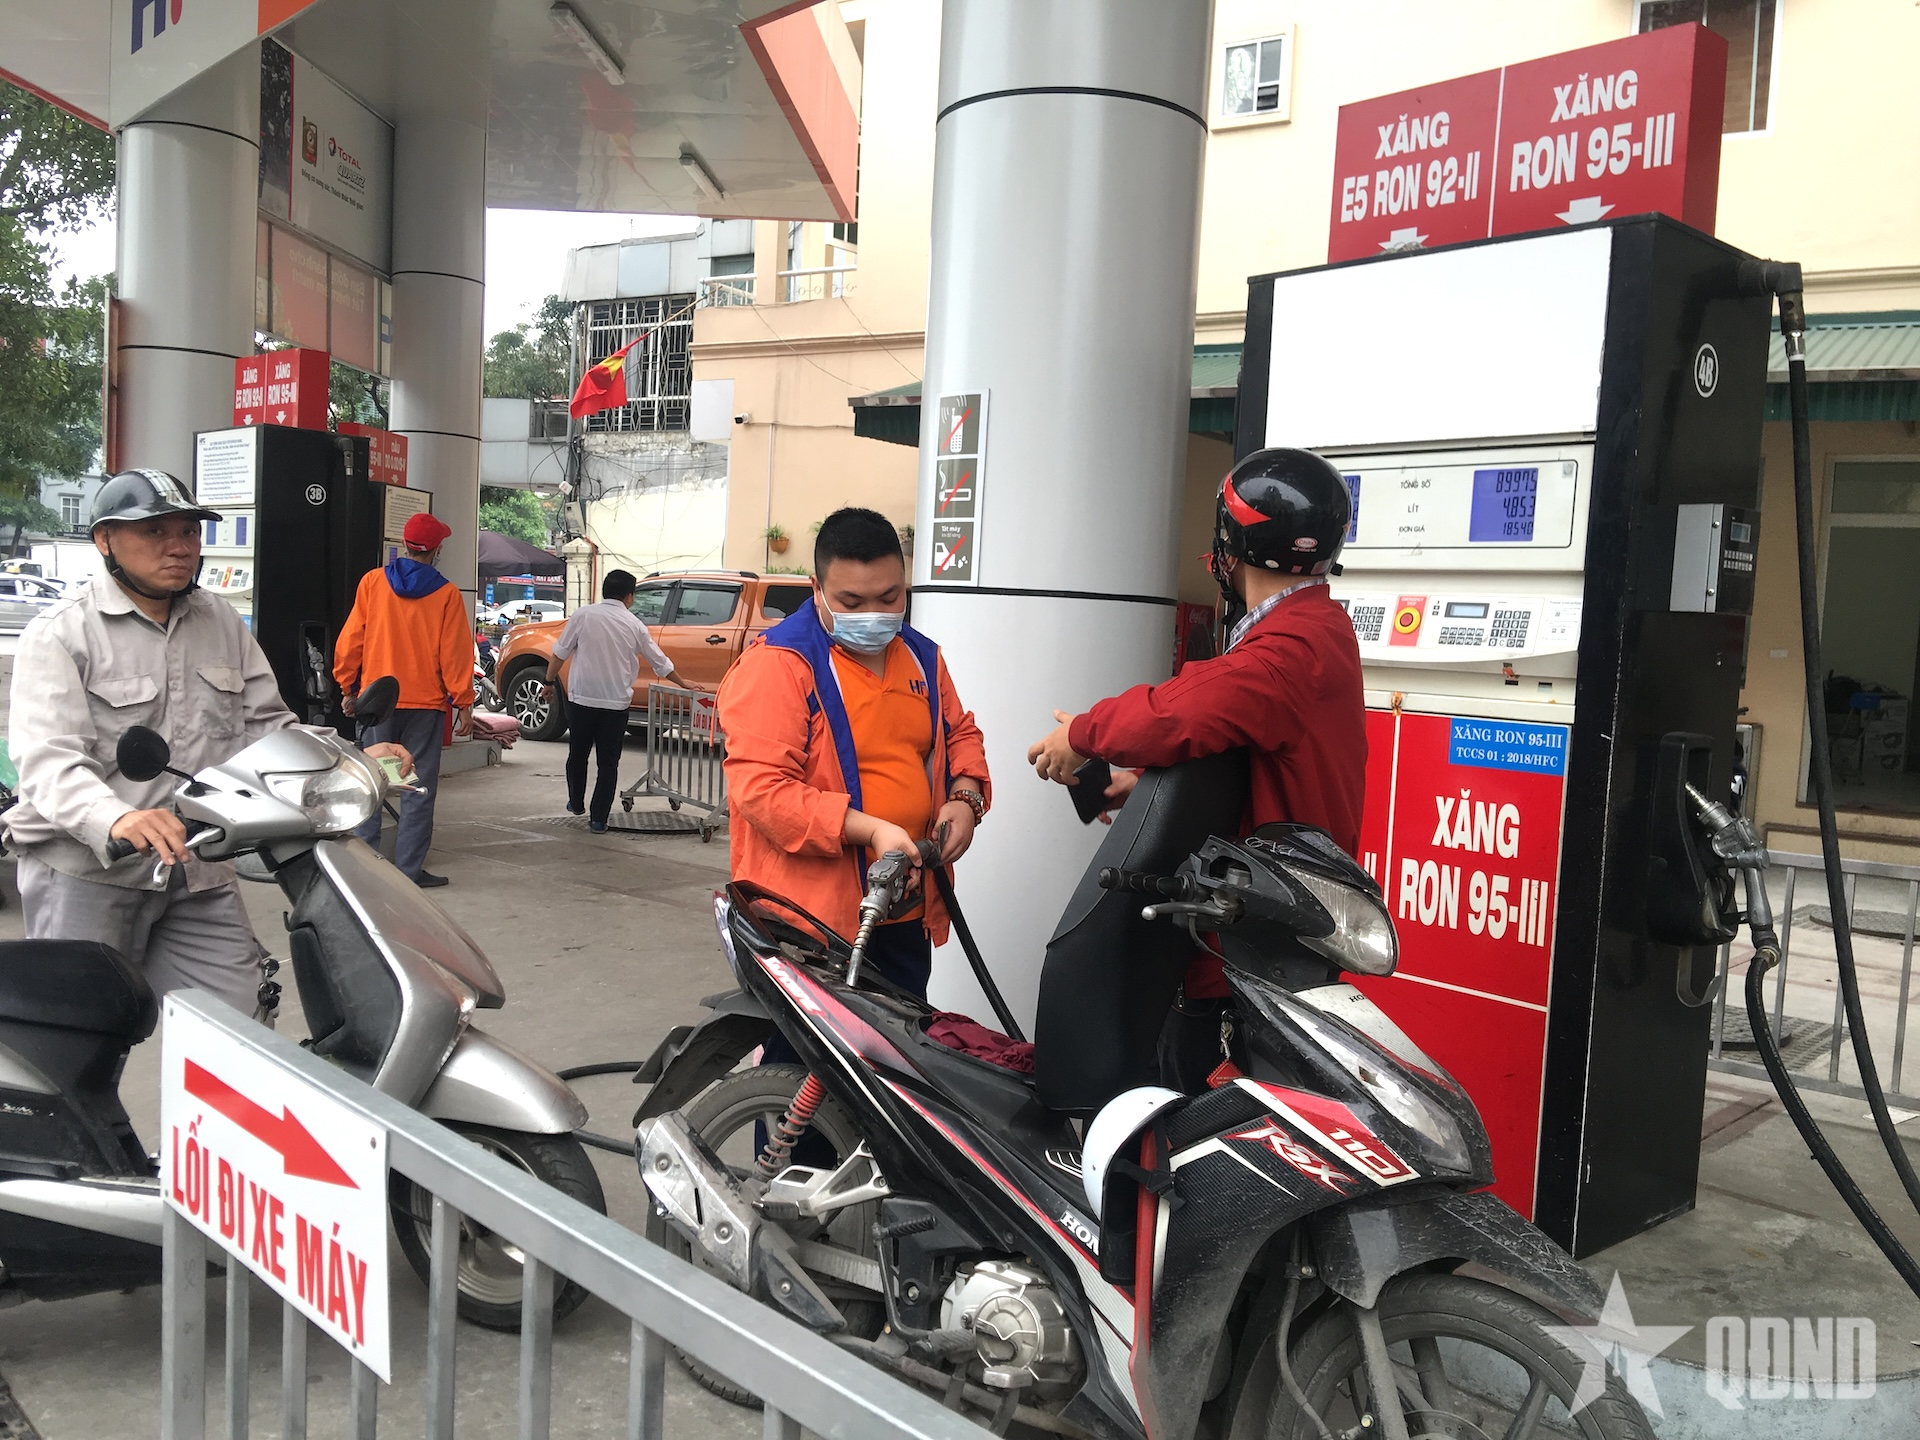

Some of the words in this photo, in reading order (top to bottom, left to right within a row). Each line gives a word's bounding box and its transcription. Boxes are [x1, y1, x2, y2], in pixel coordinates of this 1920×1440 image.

[1550, 69, 1638, 123] XĂNG
[1374, 111, 1450, 160] XĂNG
[338, 146, 362, 171] TOTAL
[1509, 131, 1578, 192] RON
[1586, 112, 1675, 180] 95-III
[1340, 174, 1369, 223] E5
[1373, 162, 1421, 217] RON
[1425, 150, 1480, 208] 92-II
[242, 367, 258, 384] XĂNG
[274, 362, 291, 380] XĂNG
[1698, 355, 1714, 388] 4B
[267, 384, 281, 405] RON
[309, 487, 323, 501] 3B
[1400, 479, 1419, 489] TỔNG
[1421, 478, 1432, 489] SỐ
[1495, 470, 1537, 493] 89975
[1407, 502, 1419, 513] LÍT
[1503, 521, 1534, 536] 18540
[1453, 724, 1492, 742] XĂNG
[1494, 729, 1526, 744] RON
[1528, 733, 1563, 749] 95-III
[1456, 746, 1485, 760] TCCS
[1486, 750, 1498, 761] 01
[1507, 752, 1558, 768] 2018/HFC
[1431, 787, 1520, 859] XĂNG
[1398, 857, 1461, 930] RON
[1467, 870, 1549, 947] 95-III
[1329, 1127, 1400, 1175] 110
[172, 1114, 210, 1225] LỐI
[218, 1155, 245, 1252] ĐI
[249, 1180, 286, 1285] XE
[295, 1213, 368, 1347] MÁY
